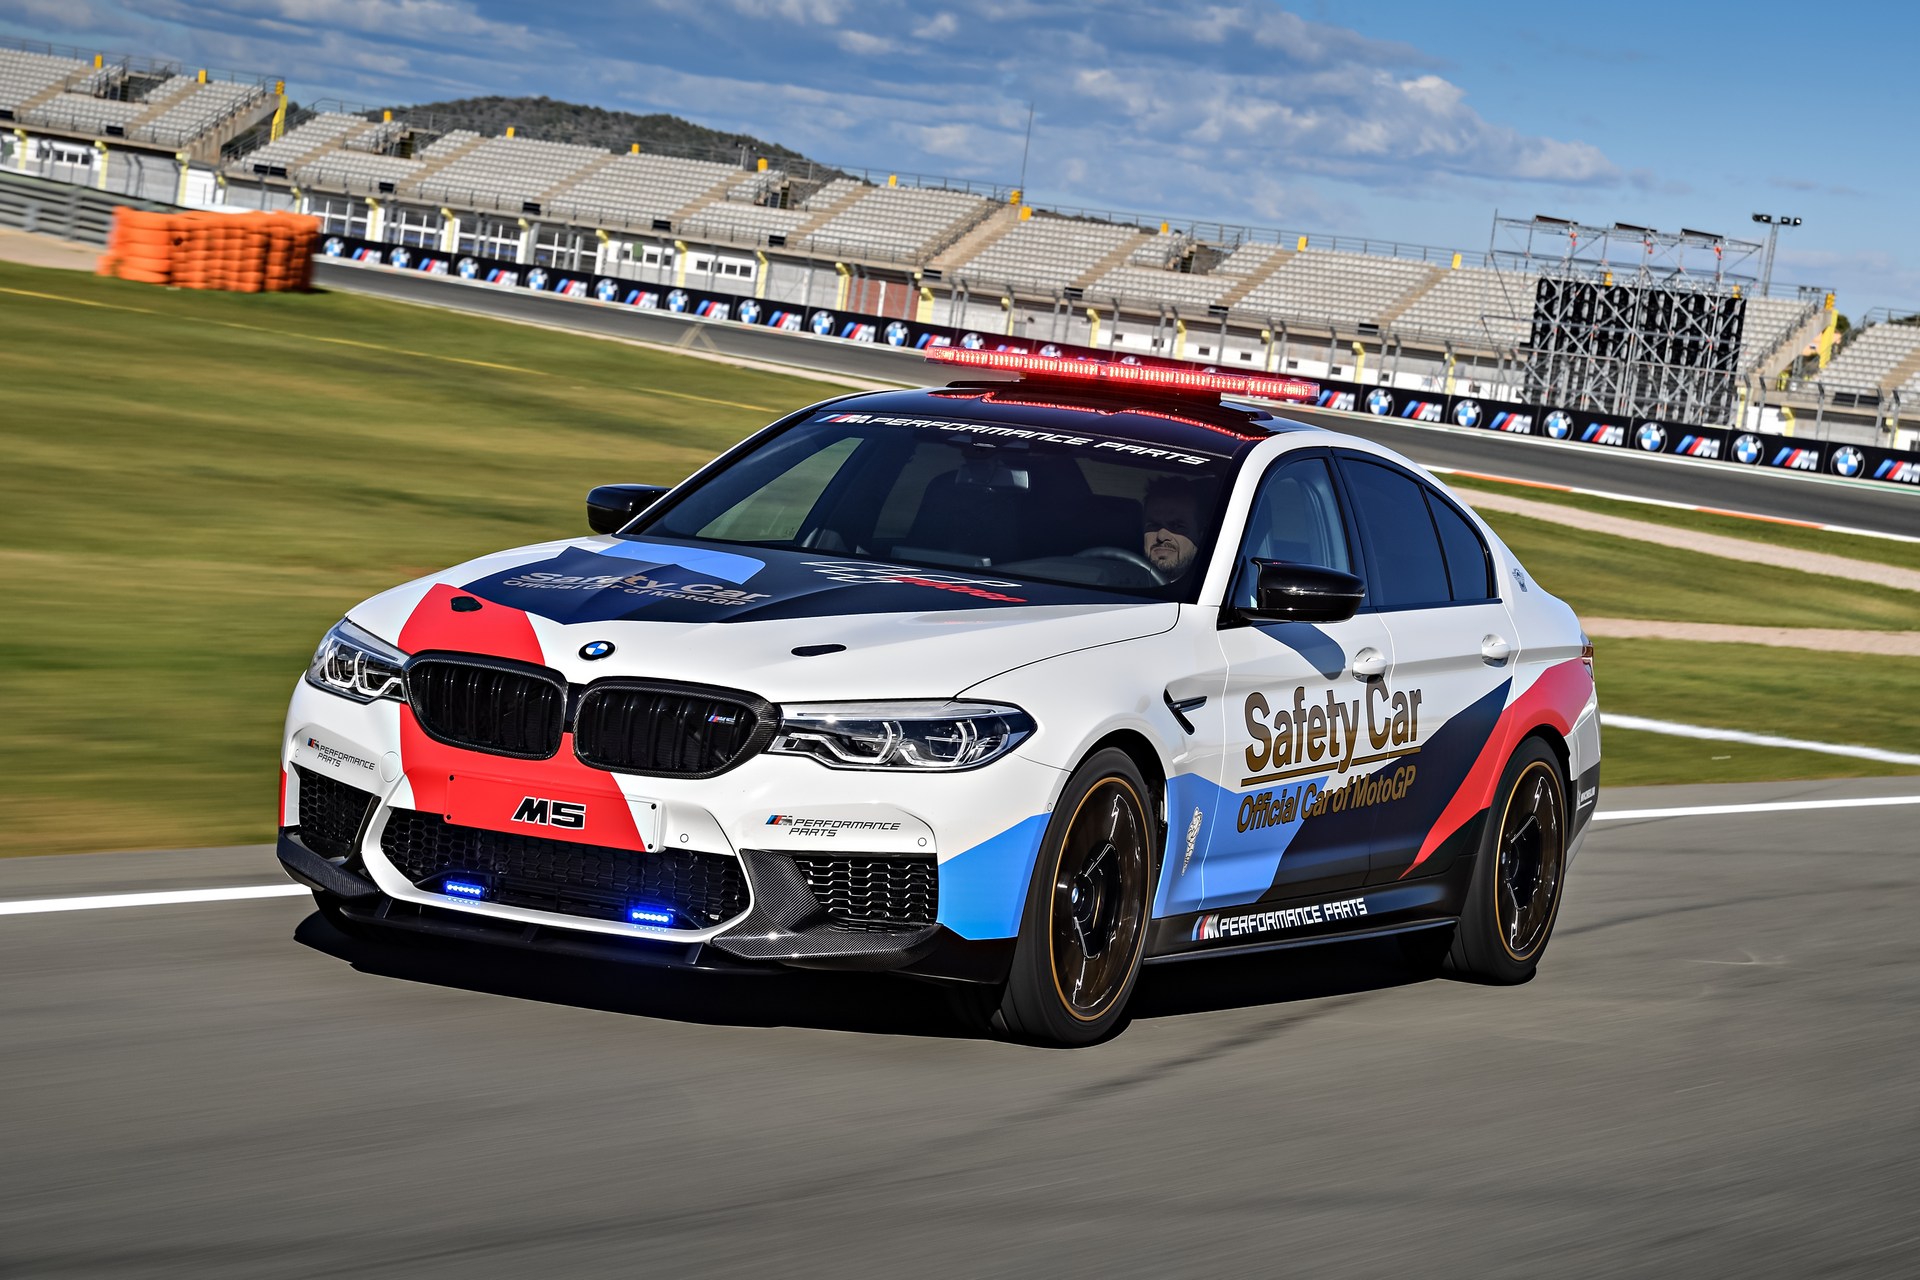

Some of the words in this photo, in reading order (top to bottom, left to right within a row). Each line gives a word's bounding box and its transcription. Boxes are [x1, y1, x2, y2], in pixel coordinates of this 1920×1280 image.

[866, 417, 1093, 446] PERFORMANCE
[1094, 441, 1211, 465] PARTS
[502, 579, 582, 590] Official
[652, 590, 746, 607] MotoGP
[519, 572, 680, 590] Safety
[681, 583, 772, 600] Car
[1244, 686, 1360, 774] Safety
[1366, 674, 1422, 750] Car
[317, 752, 342, 768] PARTS
[319, 745, 376, 770] PERFORMANCE
[510, 795, 587, 830] M5
[1236, 786, 1302, 833] Official
[1301, 783, 1332, 820] Car
[1332, 776, 1354, 813] of
[1350, 765, 1417, 809] MotoGP
[788, 827, 838, 837] PARTS
[793, 818, 902, 831] PERFORMANCE
[1219, 905, 1323, 937] PERFORMANCE
[1323, 897, 1368, 922] PARTS
